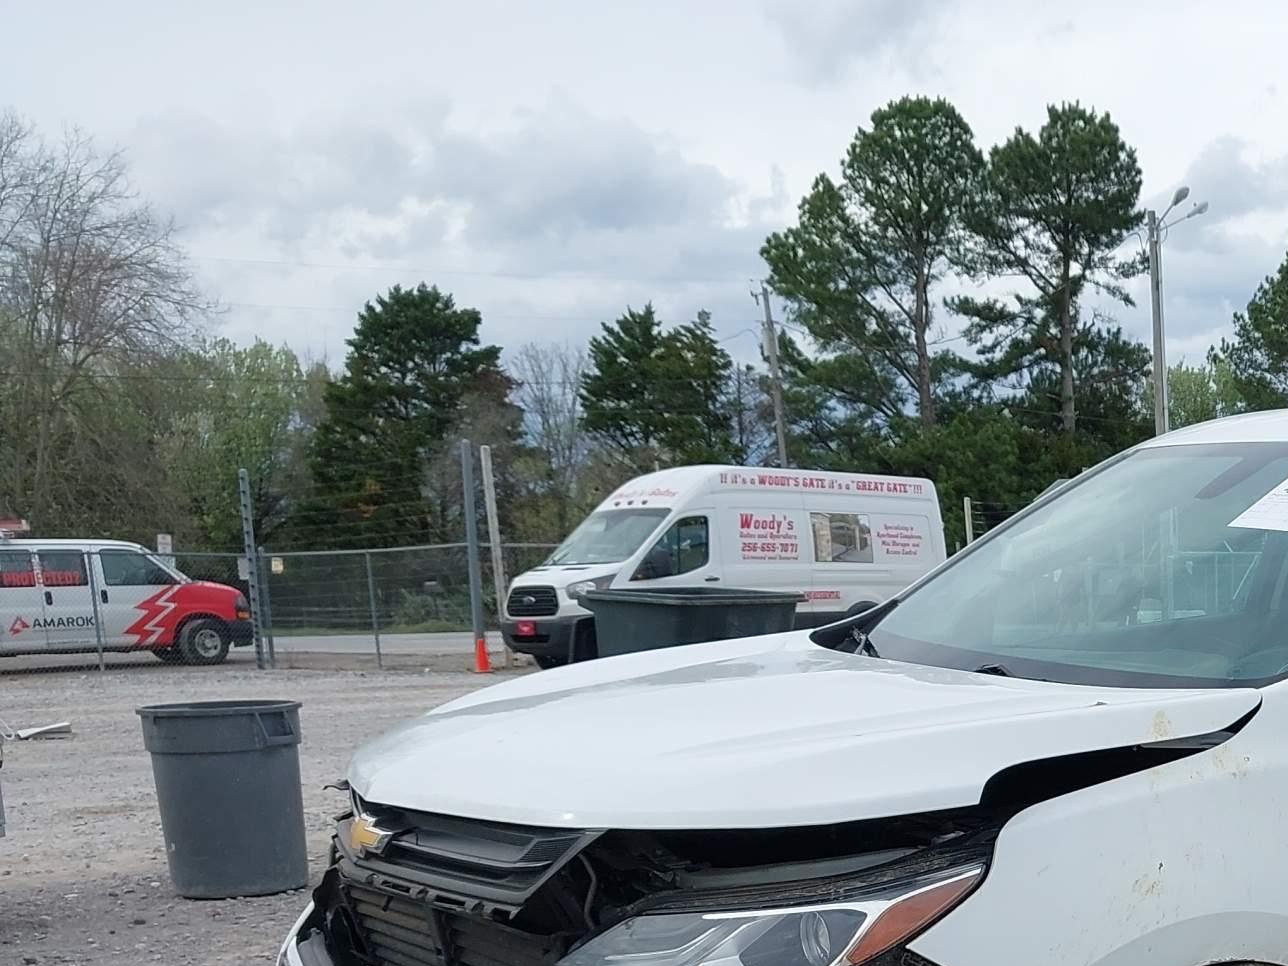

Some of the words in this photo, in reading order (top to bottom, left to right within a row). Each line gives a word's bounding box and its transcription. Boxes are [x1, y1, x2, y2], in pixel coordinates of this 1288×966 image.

[757, 474, 800, 488] WOODY'S
[802, 477, 826, 489] GATE
[739, 513, 795, 534] Woody's
[741, 542, 799, 553] 256-655-7071
[32, 616, 96, 628] AMAROK
